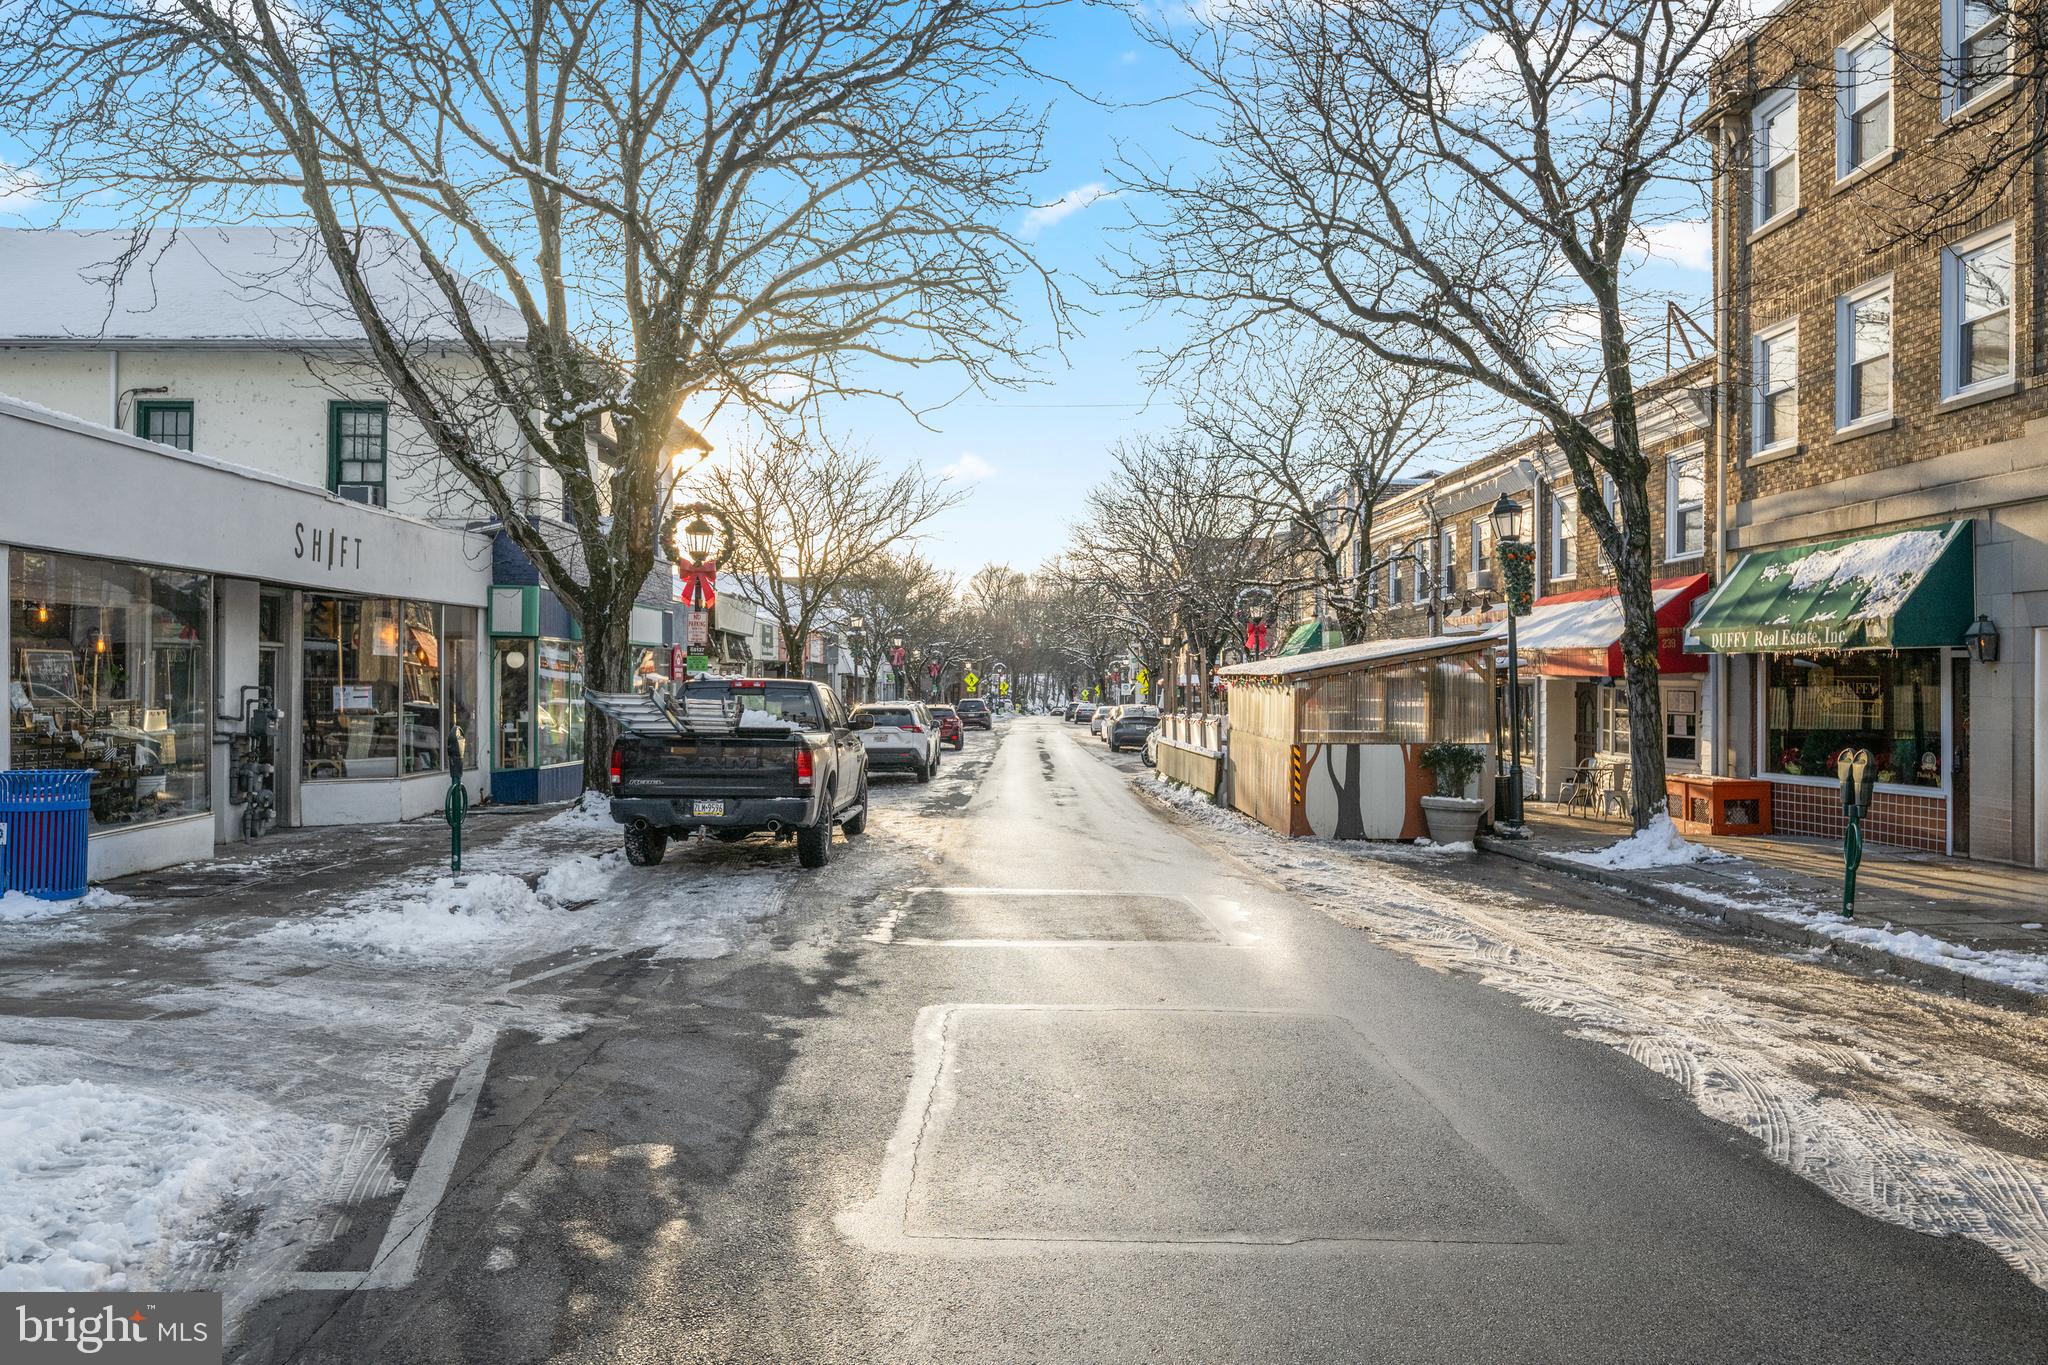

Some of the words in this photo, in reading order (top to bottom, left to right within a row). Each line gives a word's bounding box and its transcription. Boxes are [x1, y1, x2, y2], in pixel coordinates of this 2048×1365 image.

[294, 522, 362, 571] SHIFT
[1661, 638, 1677, 649] 239
[1711, 631, 1750, 649] DUFFY
[1754, 629, 1779, 647] Real
[1782, 628, 1822, 648] Estate,
[1824, 626, 1848, 645] Inc.
